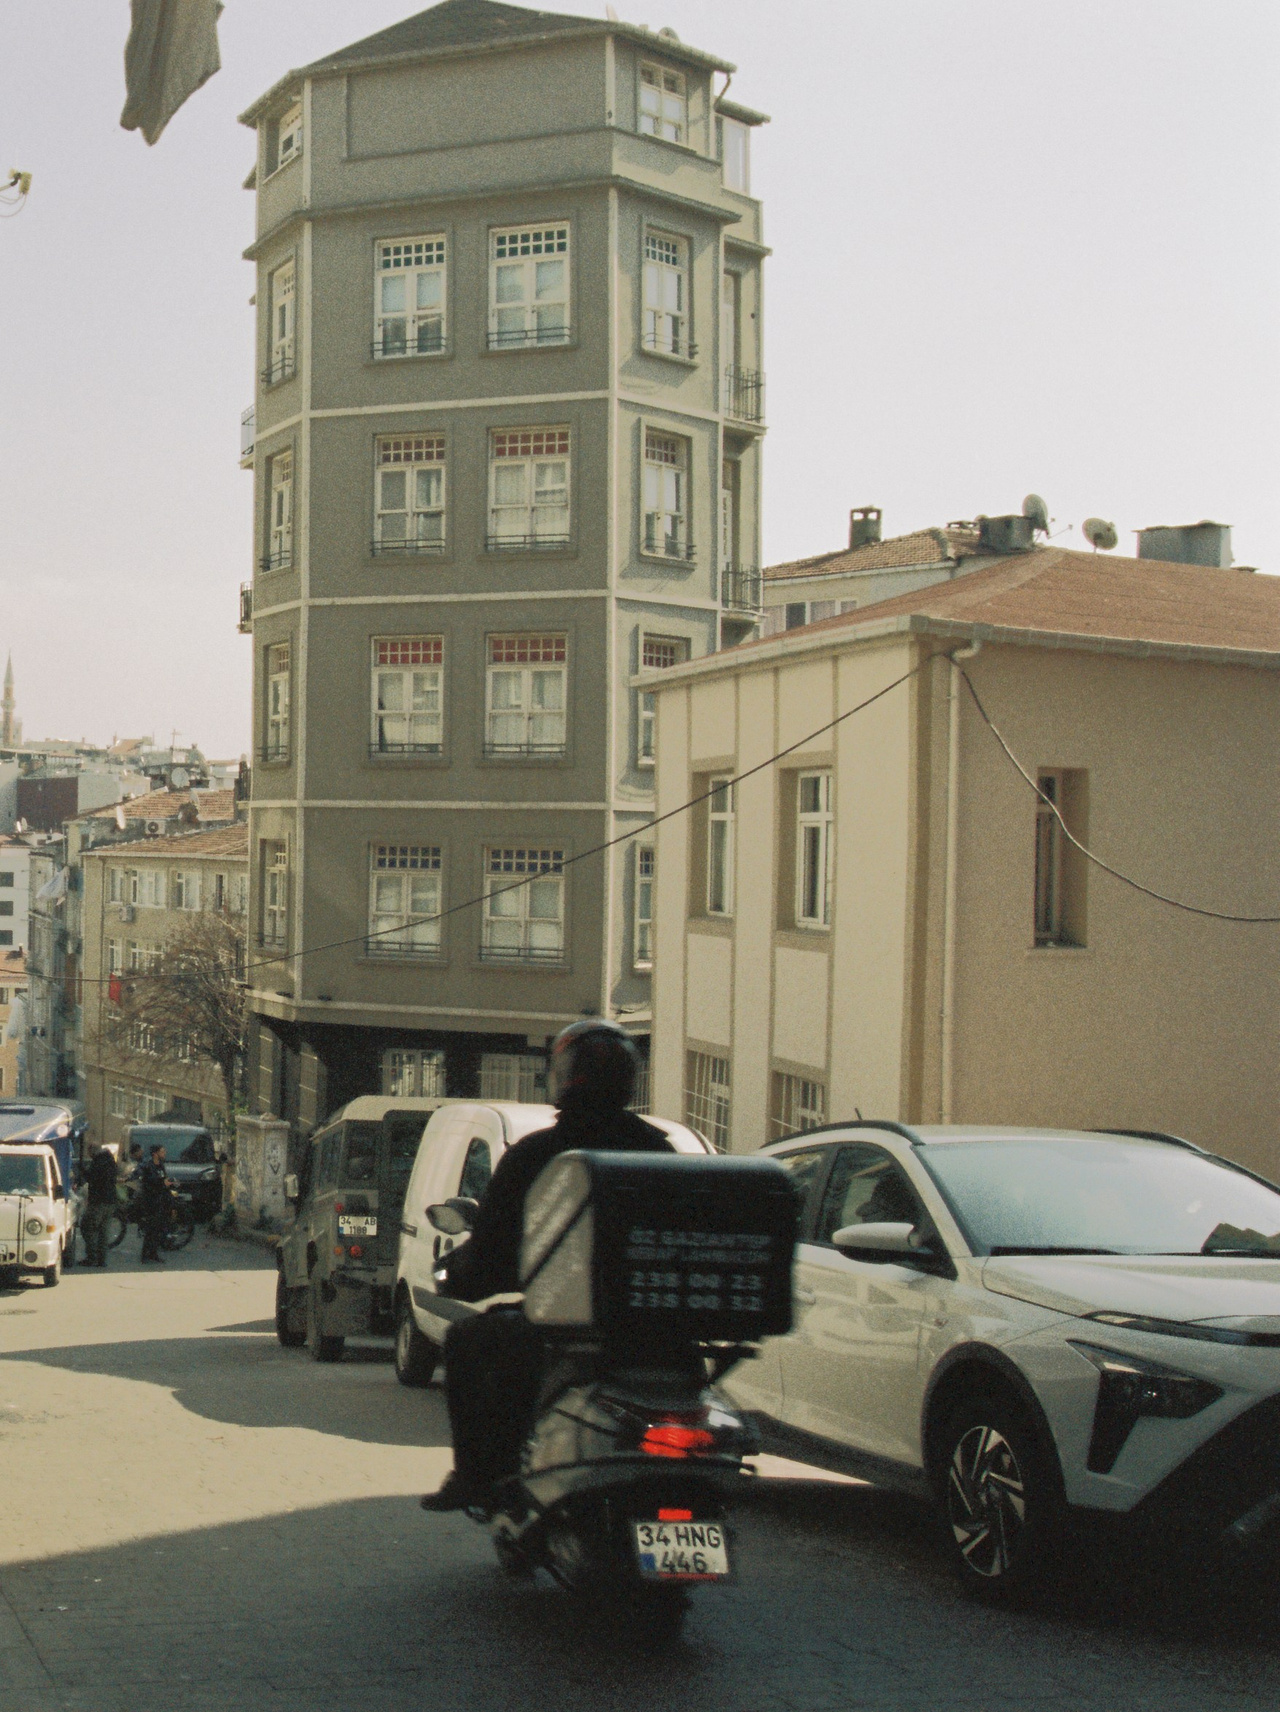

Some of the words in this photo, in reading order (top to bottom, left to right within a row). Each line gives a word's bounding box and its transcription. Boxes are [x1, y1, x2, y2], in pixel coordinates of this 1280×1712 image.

[639, 1525, 671, 1547] 34
[674, 1526, 721, 1548] HNG
[660, 1551, 708, 1574] 446
